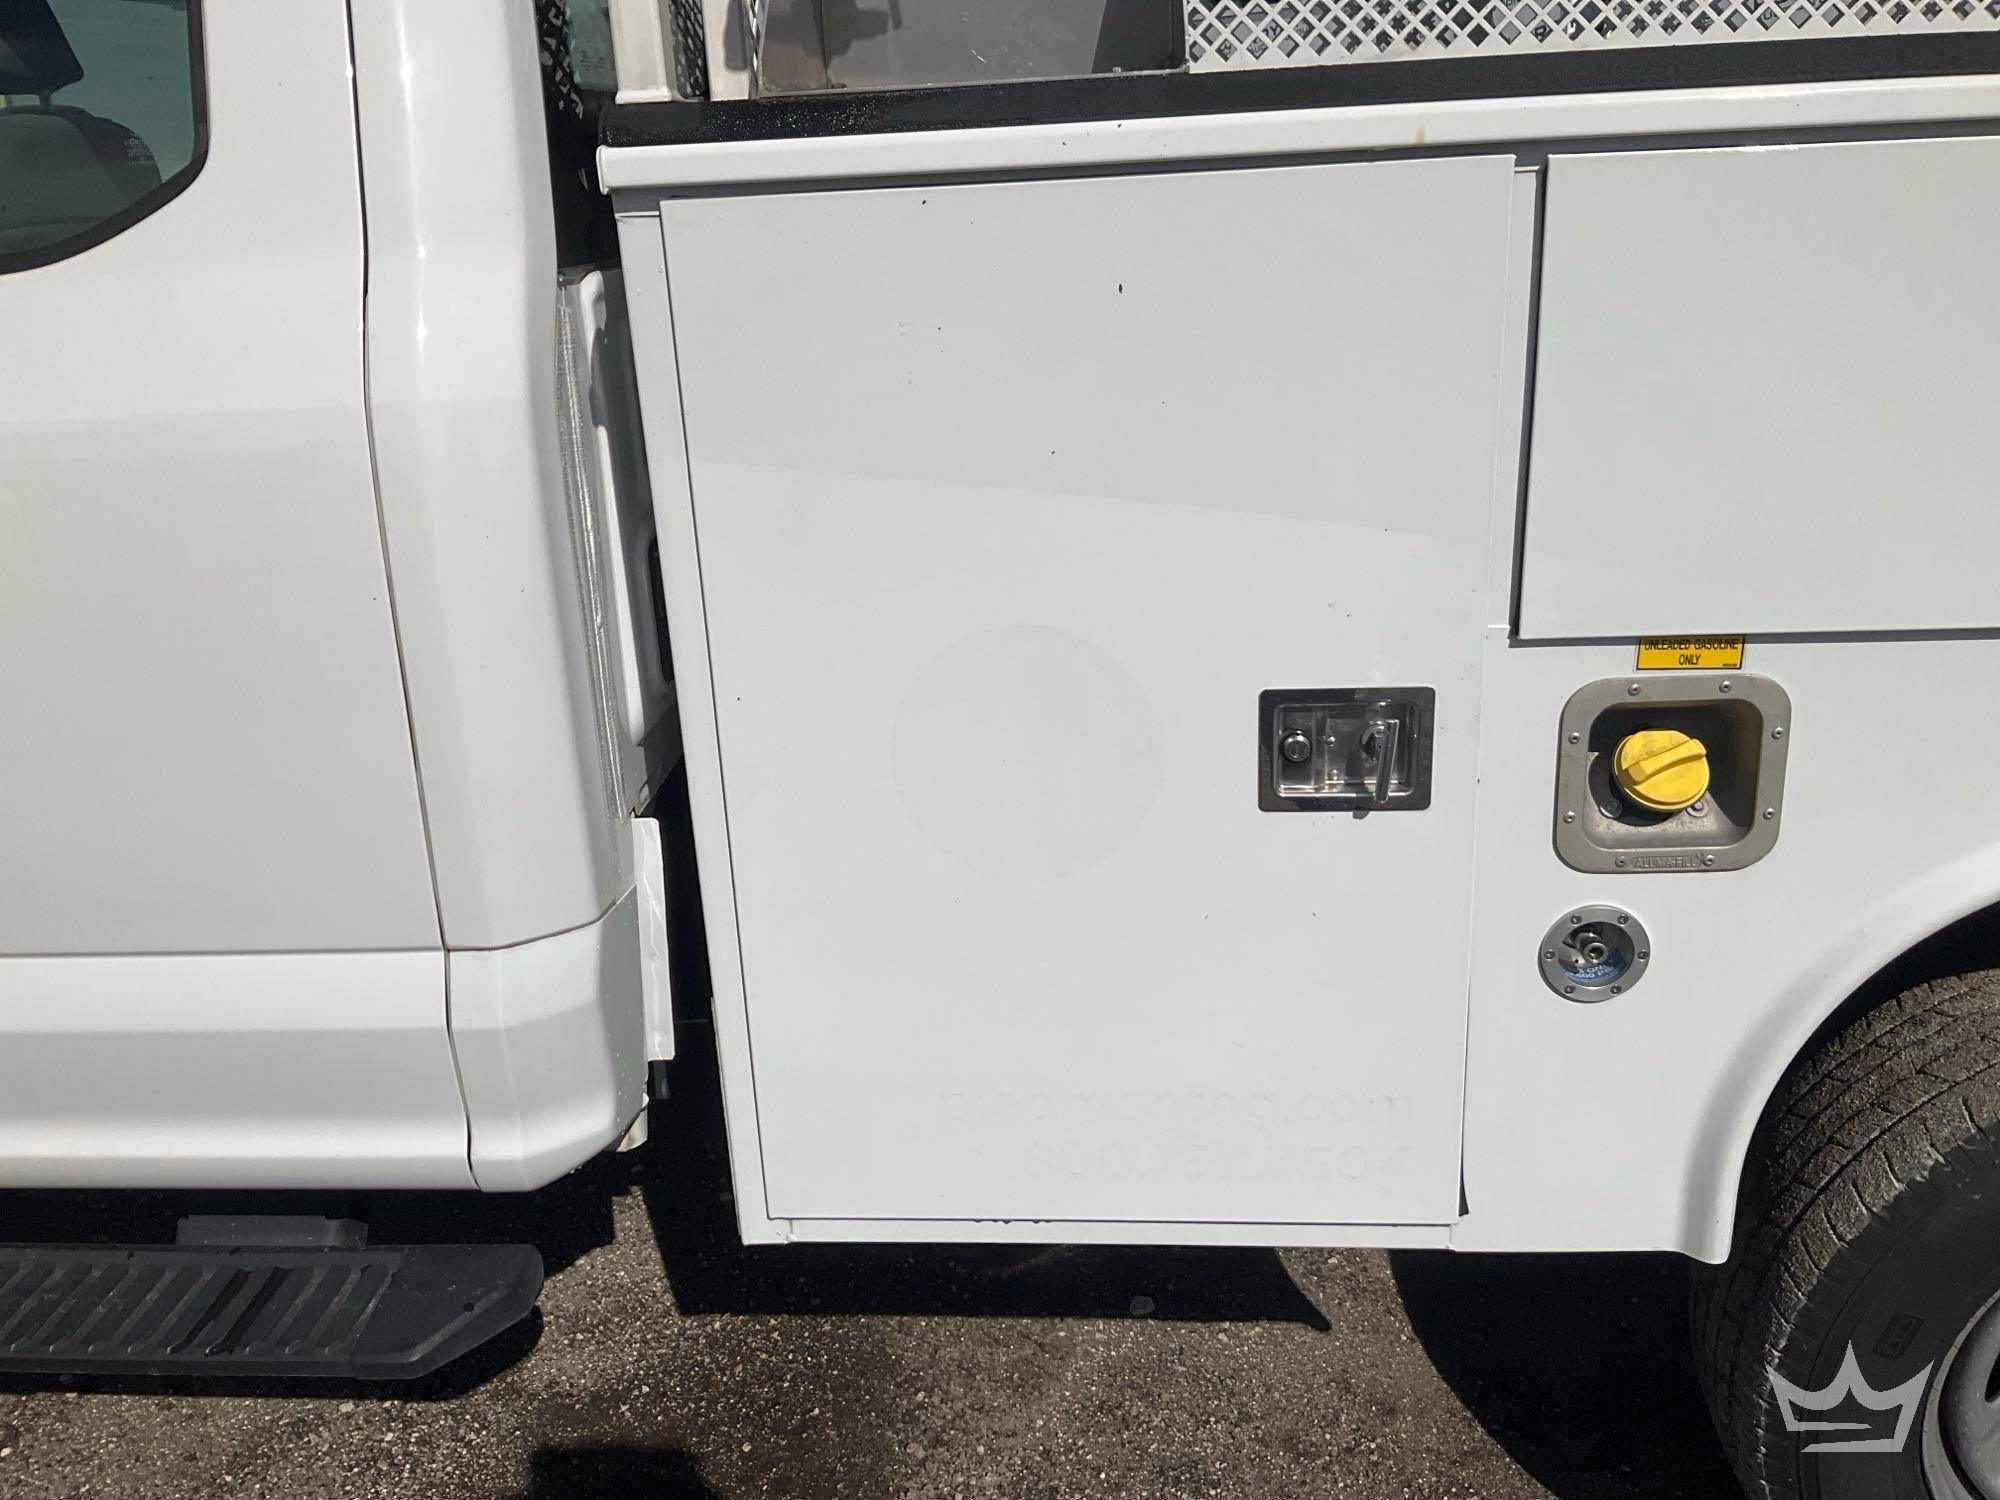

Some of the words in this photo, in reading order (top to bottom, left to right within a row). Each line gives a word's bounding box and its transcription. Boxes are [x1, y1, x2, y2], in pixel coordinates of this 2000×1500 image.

[1644, 639, 1690, 650] UNLEADED
[1694, 638, 1738, 650] GASOLINE
[1678, 654, 1701, 665] ONLY
